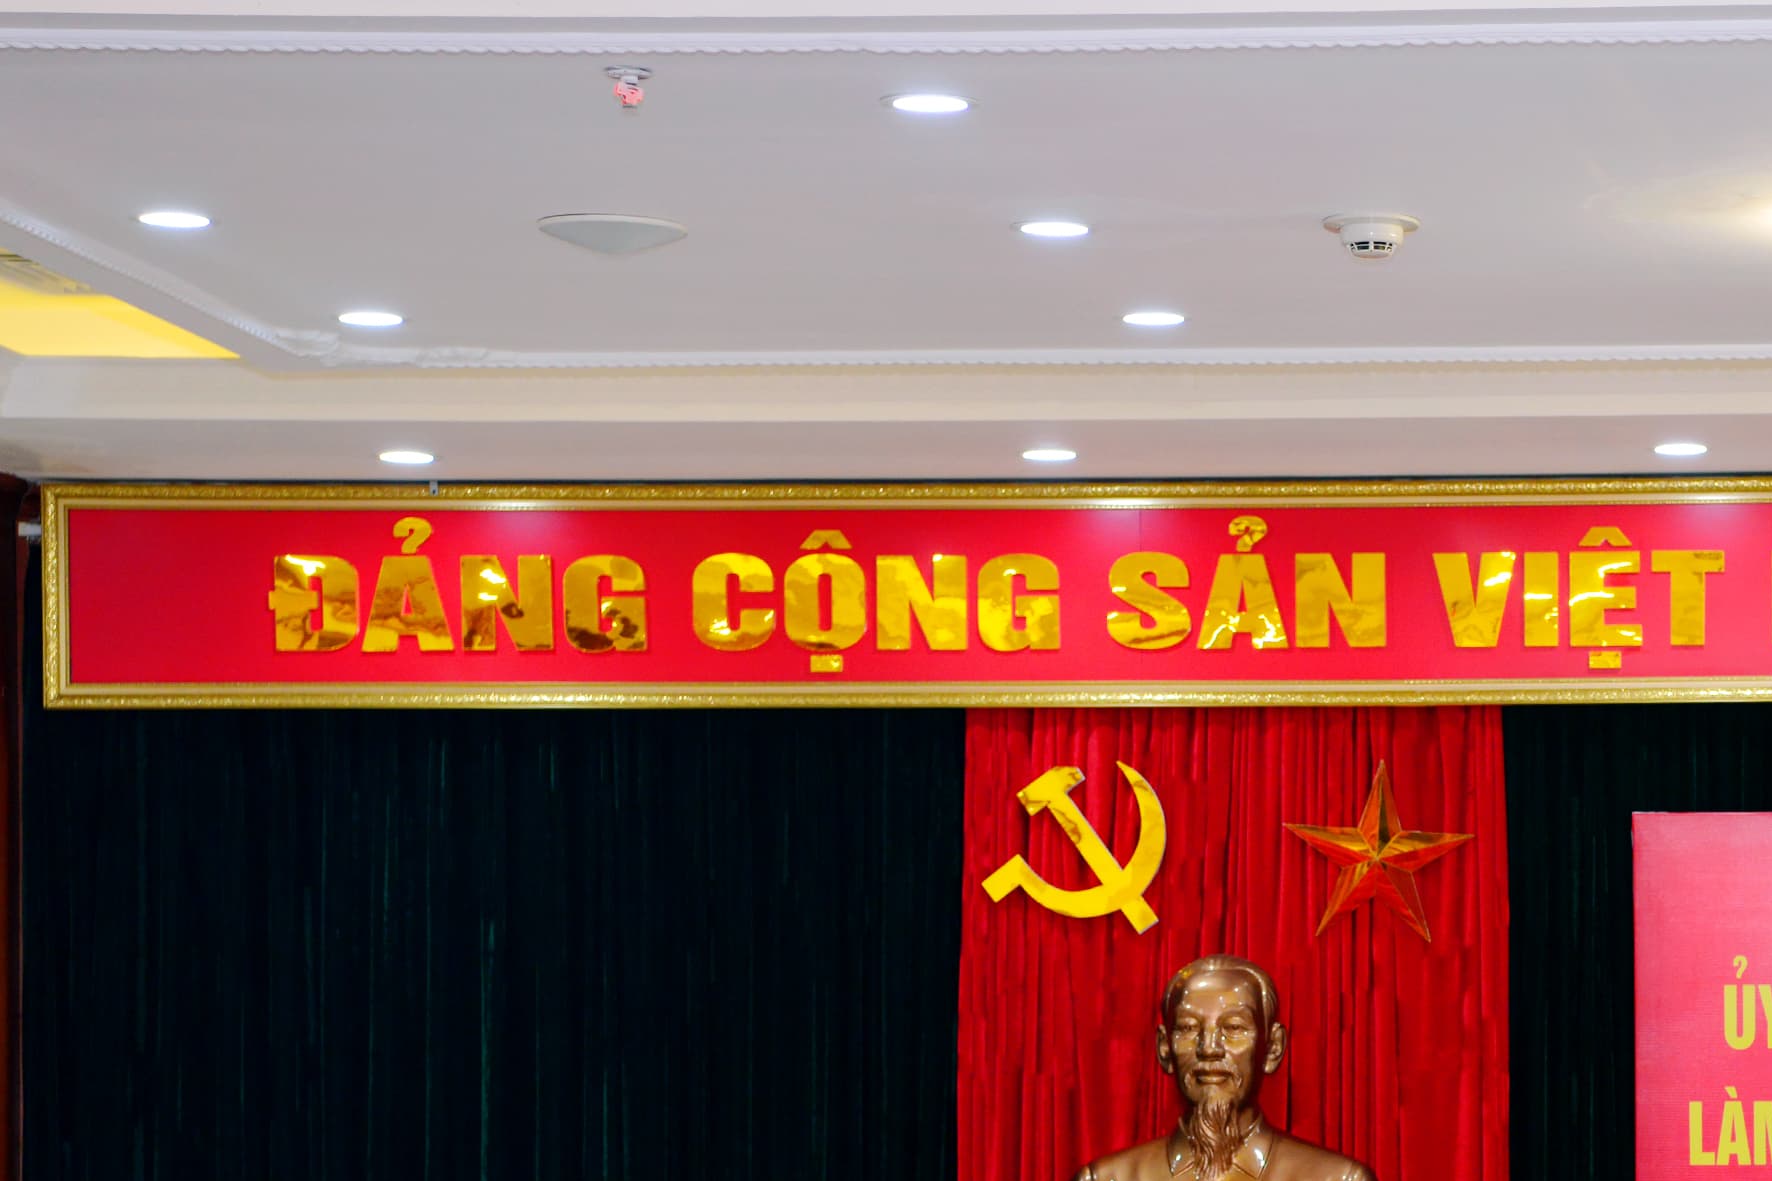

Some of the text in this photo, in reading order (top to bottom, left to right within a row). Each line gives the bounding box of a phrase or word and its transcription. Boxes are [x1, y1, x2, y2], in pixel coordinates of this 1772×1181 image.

[268, 516, 649, 653] ĐẢNG
[691, 529, 1062, 673] CỘNG
[1106, 515, 1387, 651] SẢN
[1432, 526, 1726, 670] VIỆT
